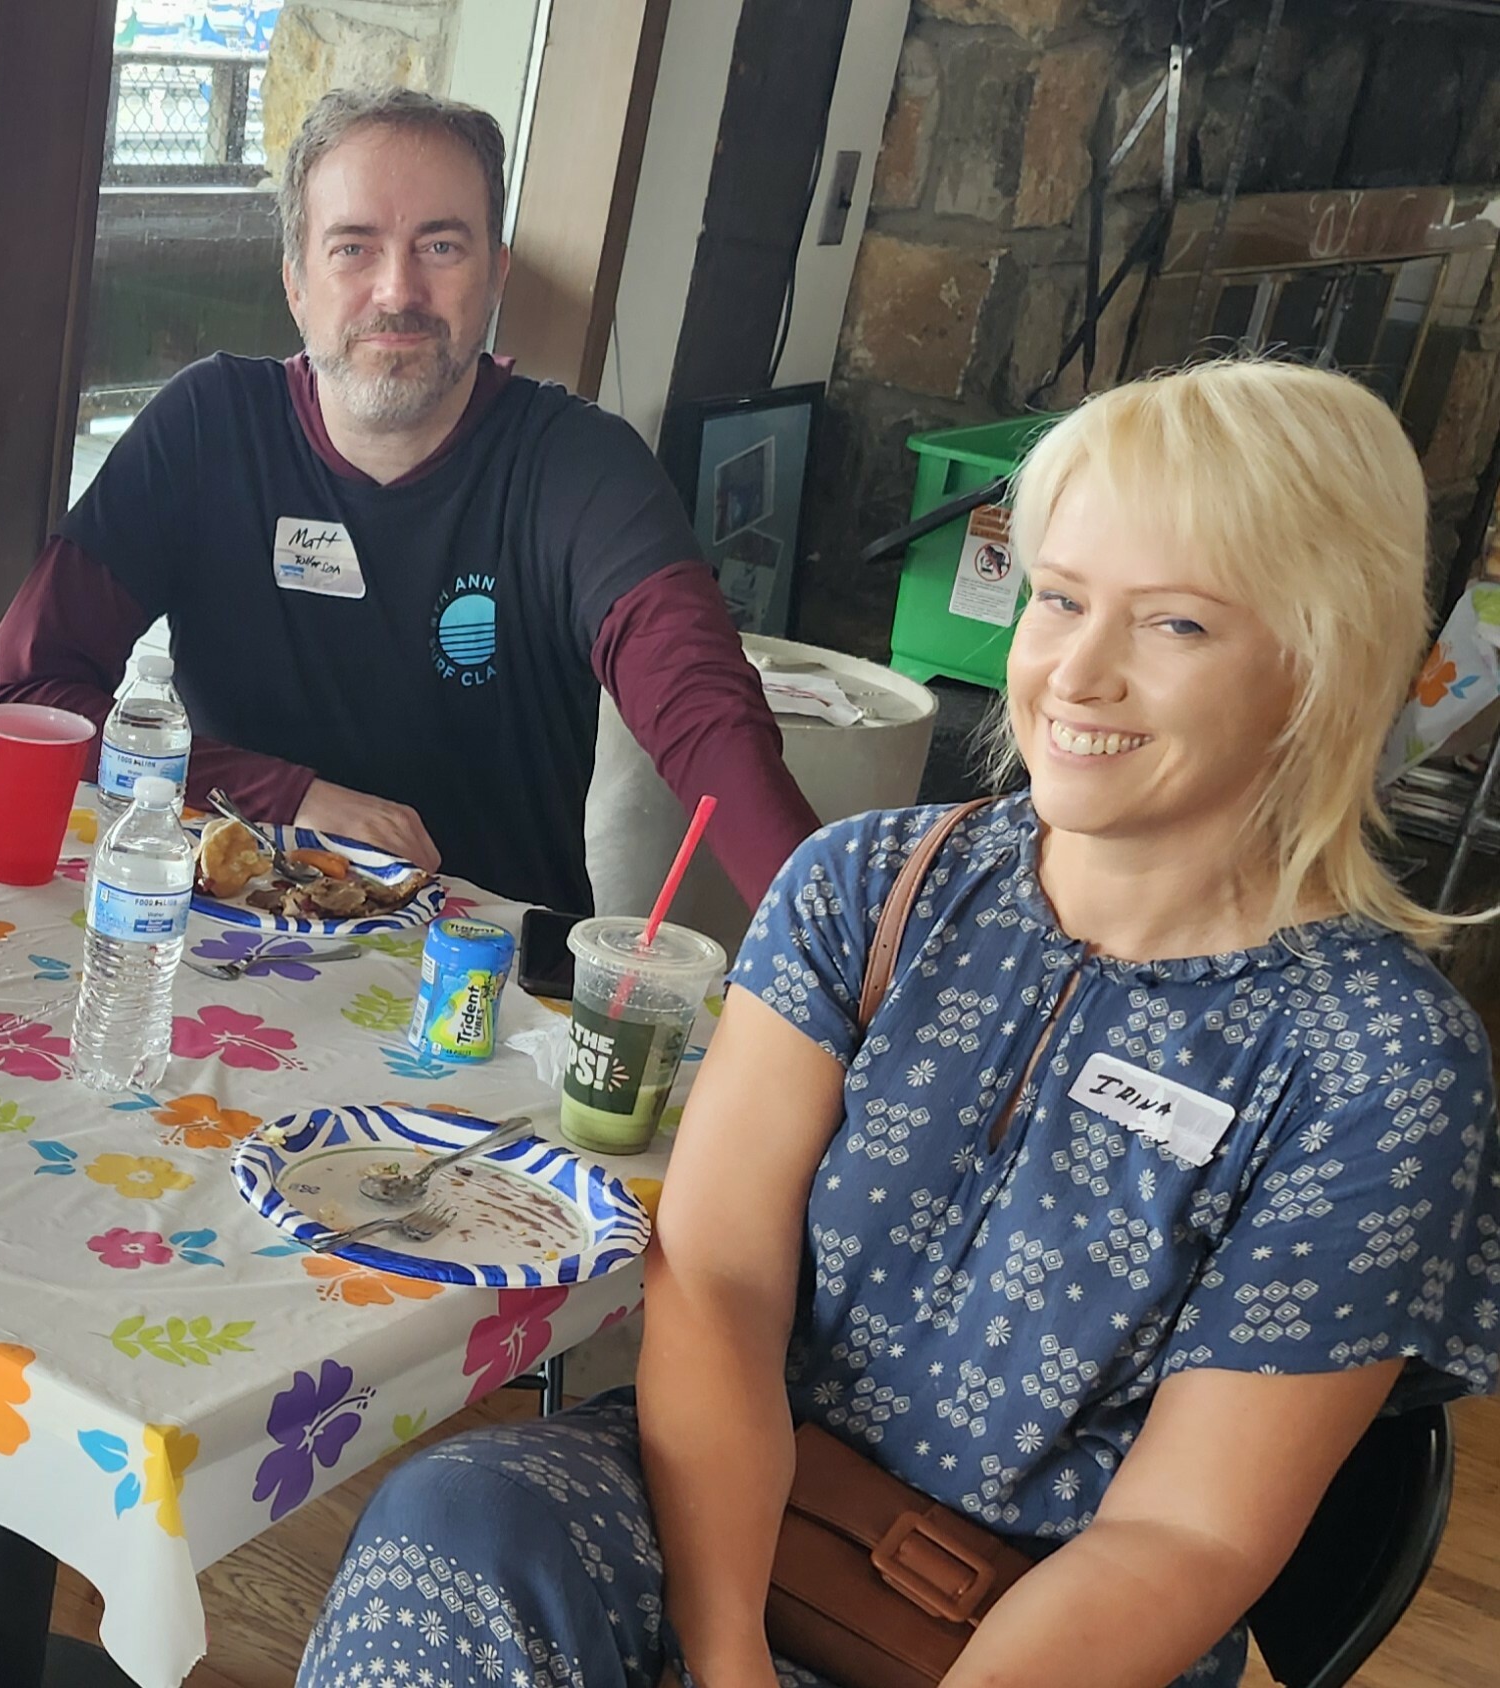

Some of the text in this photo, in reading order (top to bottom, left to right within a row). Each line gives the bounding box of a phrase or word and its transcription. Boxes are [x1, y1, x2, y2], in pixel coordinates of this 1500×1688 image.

[288, 528, 342, 550] Matt
[457, 985, 480, 1044] Trident
[574, 1021, 615, 1055] THE
[1089, 1074, 1172, 1116] IRINA
